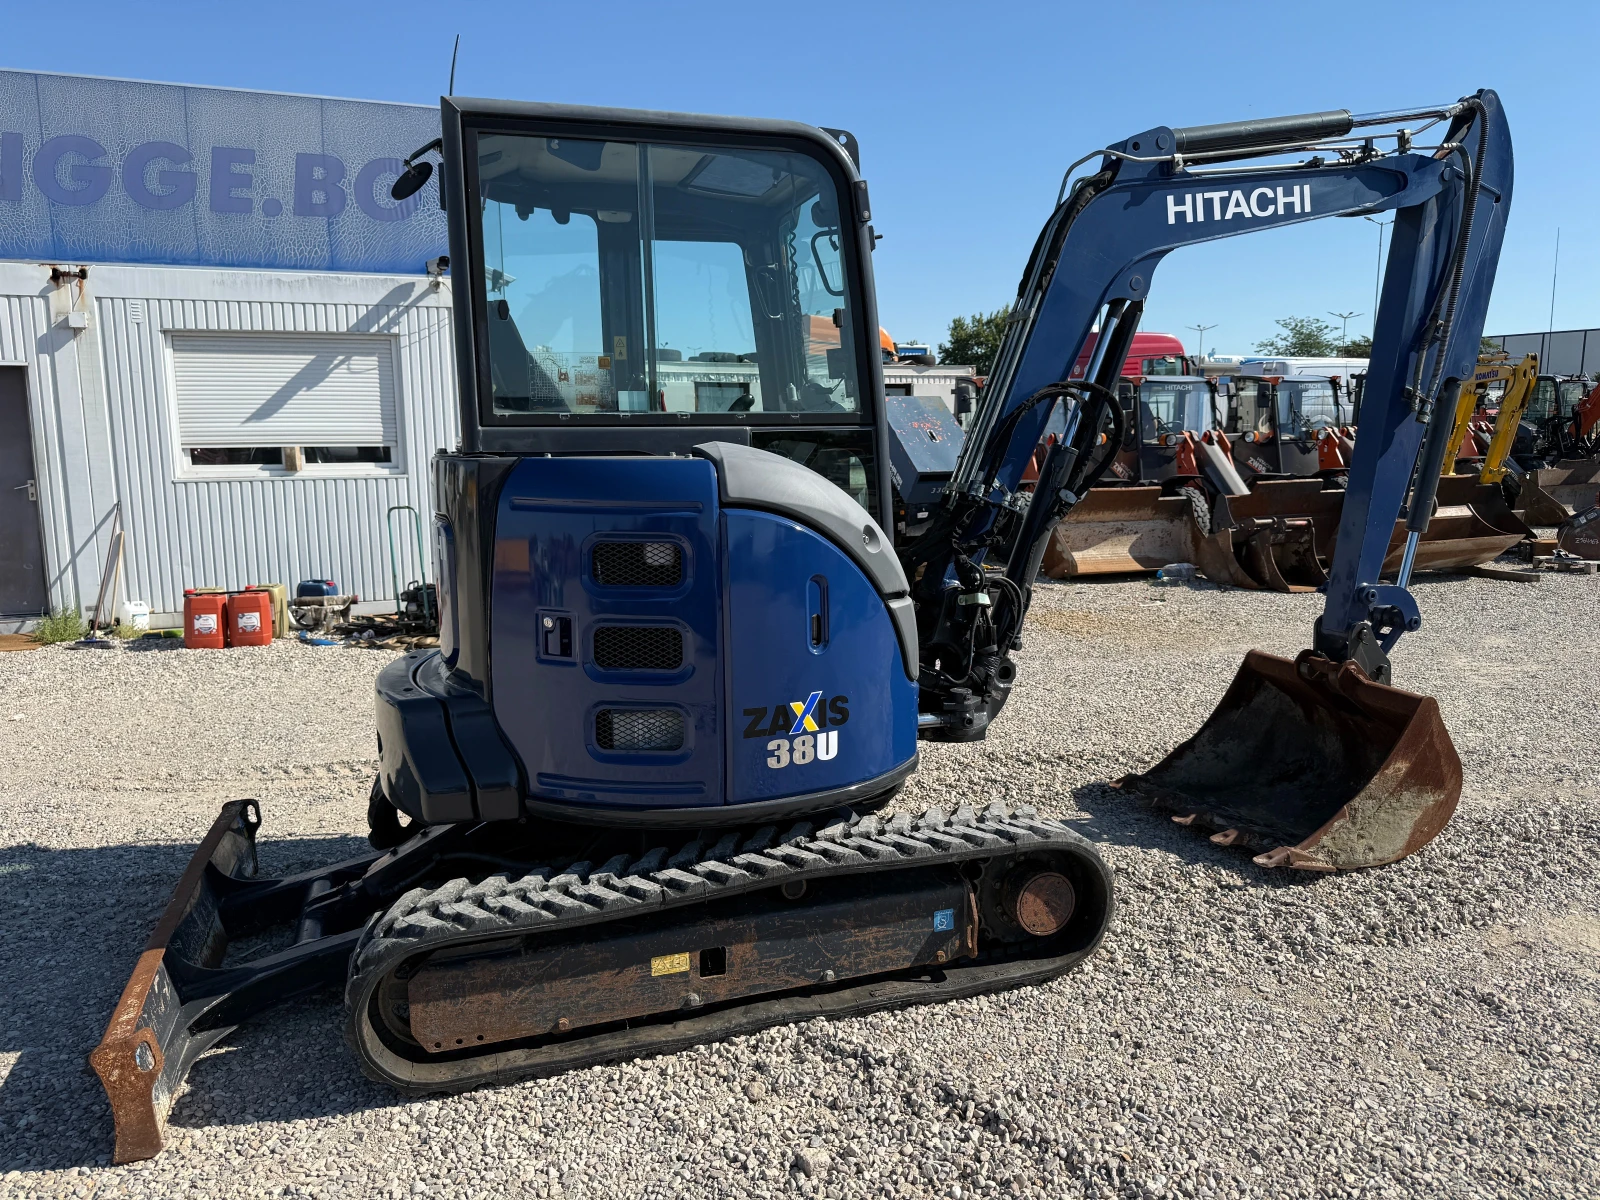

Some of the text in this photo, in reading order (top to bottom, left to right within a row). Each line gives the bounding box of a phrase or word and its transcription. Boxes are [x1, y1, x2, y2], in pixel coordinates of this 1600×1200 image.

[1166, 184, 1312, 225] HITACHI
[1475, 369, 1499, 381] KOMATSU
[743, 690, 850, 739] ZAXIS
[766, 730, 839, 769] 38U
